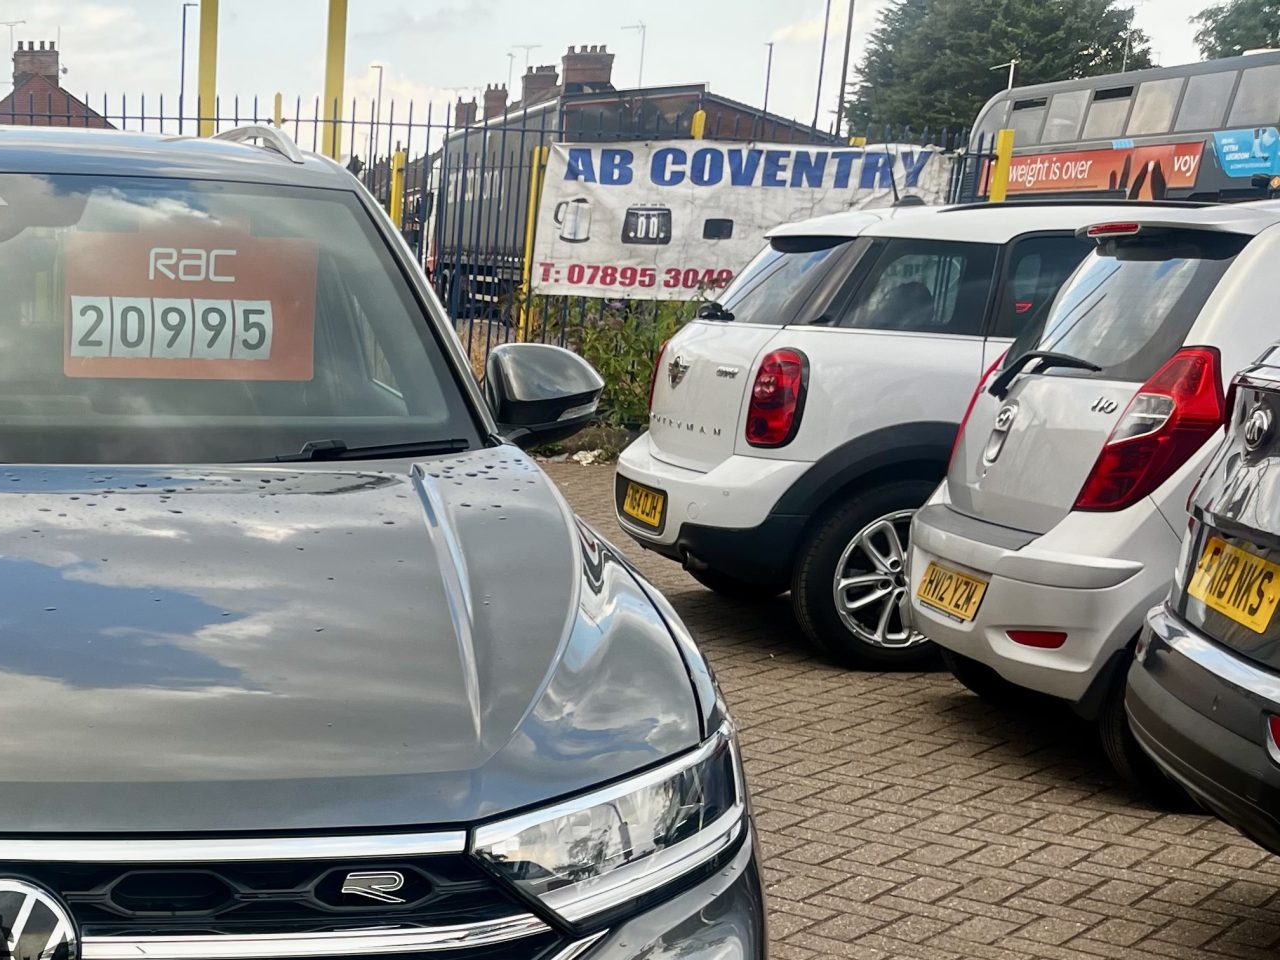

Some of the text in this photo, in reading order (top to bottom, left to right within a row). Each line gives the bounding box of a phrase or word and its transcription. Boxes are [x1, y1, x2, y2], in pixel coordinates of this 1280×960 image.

[564, 148, 932, 188] AB COVENTRY
[1008, 158, 1049, 187] weight
[1049, 158, 1060, 180] is
[1062, 160, 1093, 180] over
[1174, 155, 1200, 176] voy
[539, 262, 561, 283] T:
[567, 264, 657, 288] 07895
[77, 304, 267, 350] 20995
[1227, 560, 1274, 617] NKS
